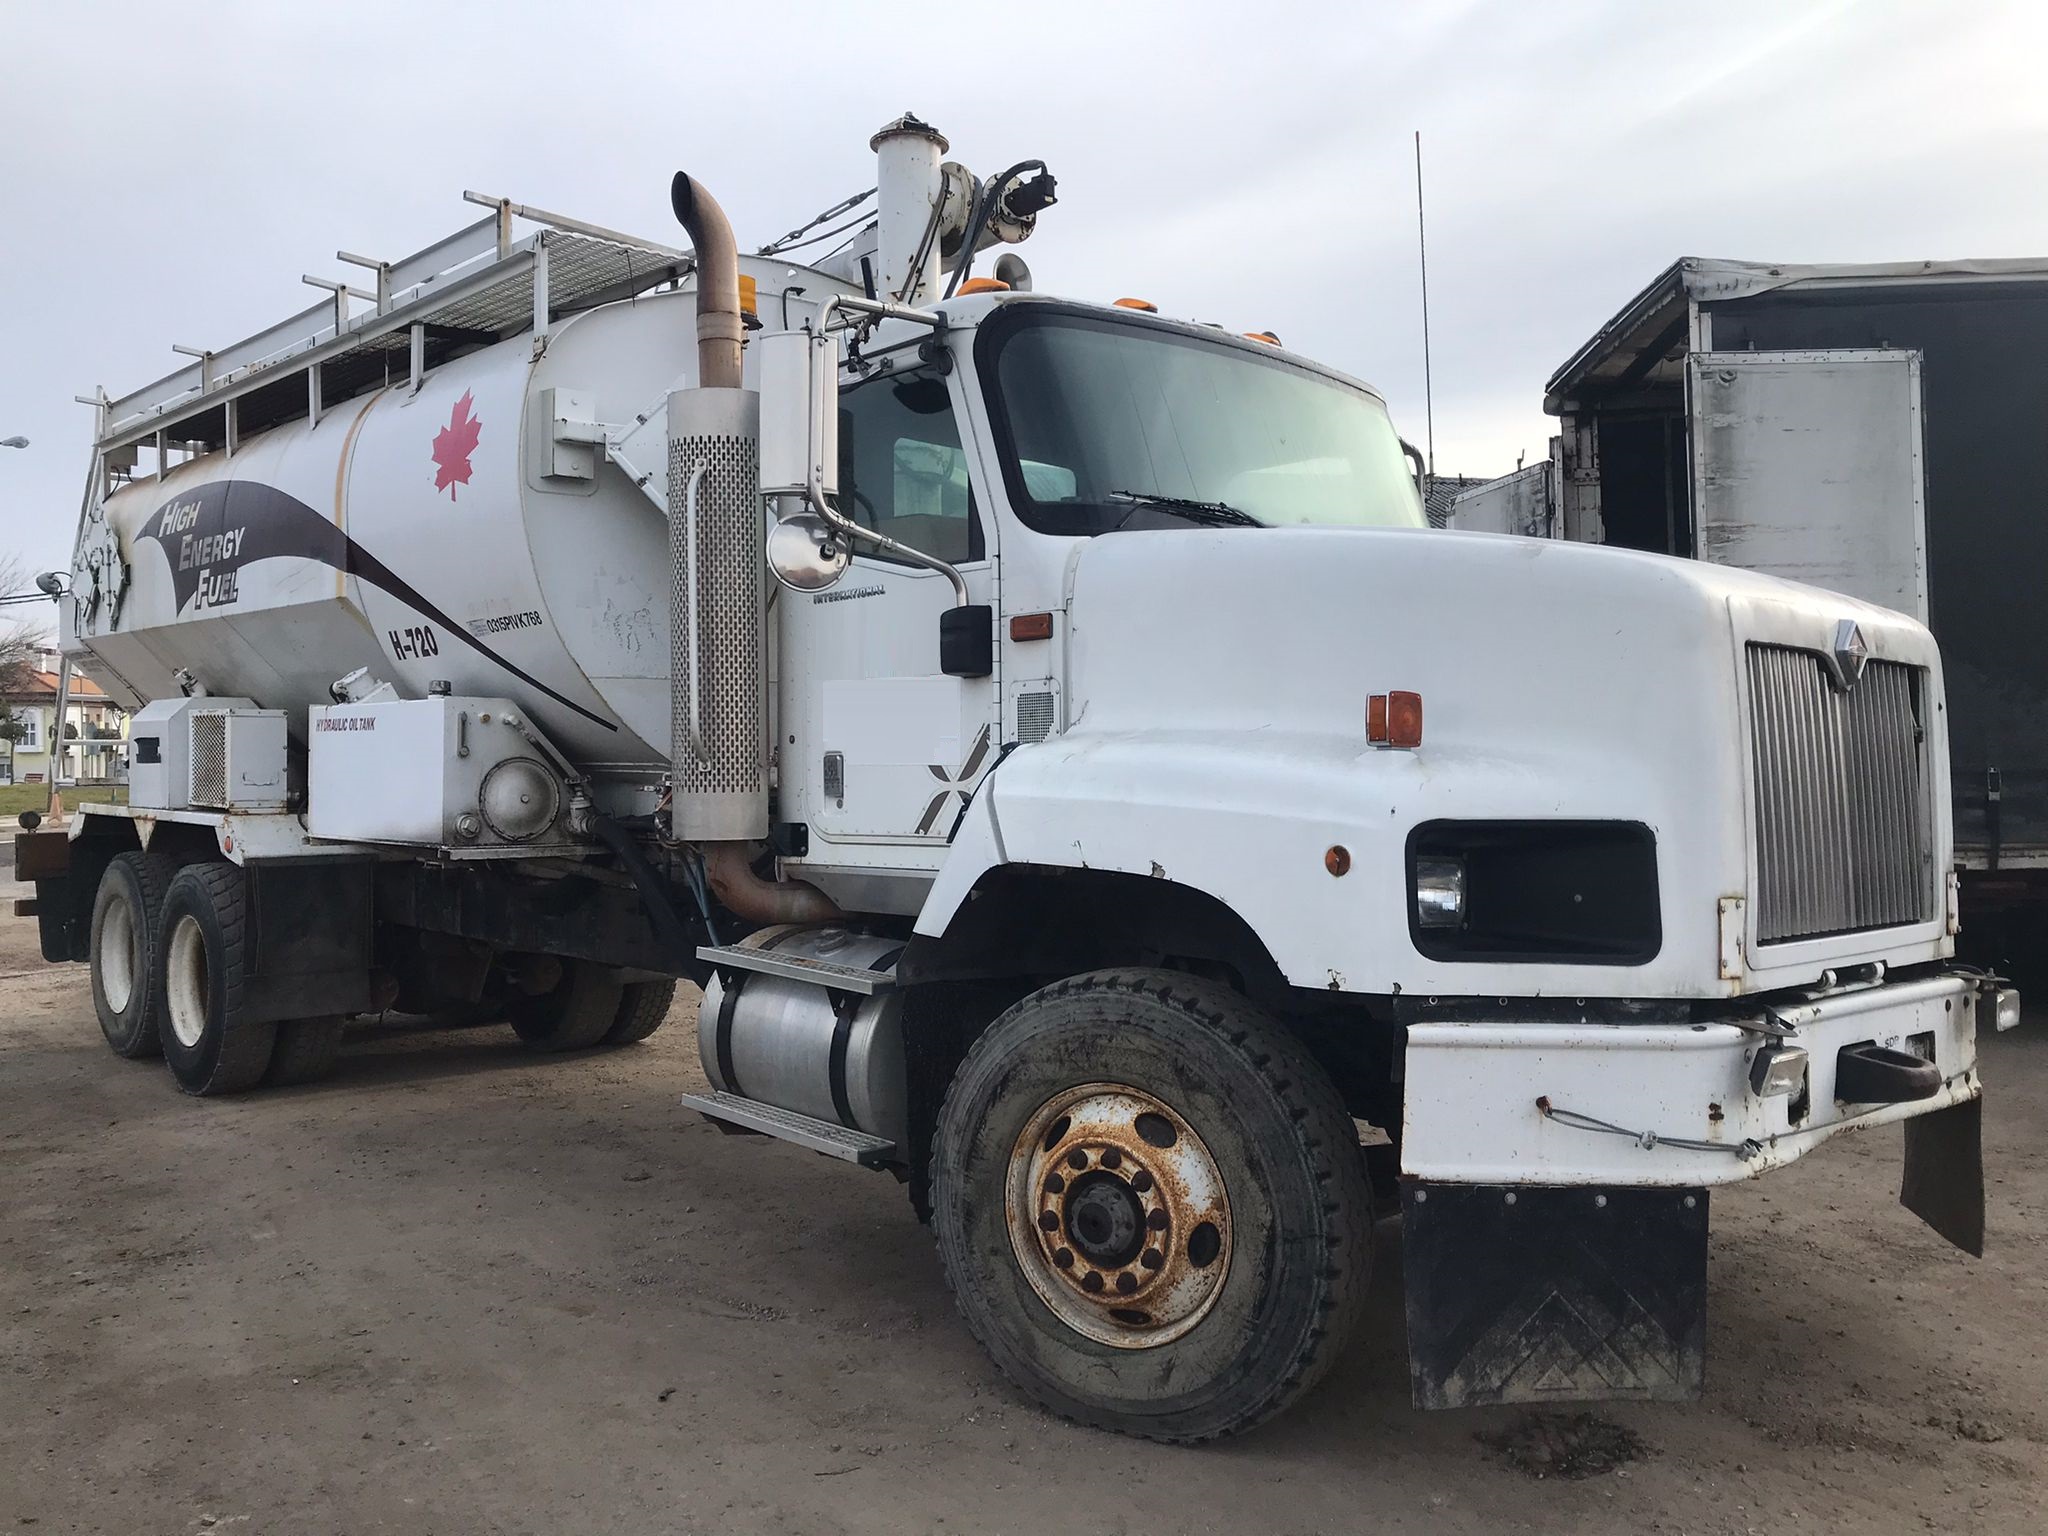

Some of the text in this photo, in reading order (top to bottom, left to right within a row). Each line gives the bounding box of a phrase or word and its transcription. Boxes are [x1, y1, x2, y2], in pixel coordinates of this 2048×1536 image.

[158, 500, 202, 538] HIGH
[178, 526, 246, 572] ENERGY
[194, 568, 239, 611] FUEL
[813, 584, 886, 605] INTERNATIONAL
[388, 625, 439, 661] H-720
[316, 717, 376, 732] HYDRAULIC OIL TANK
